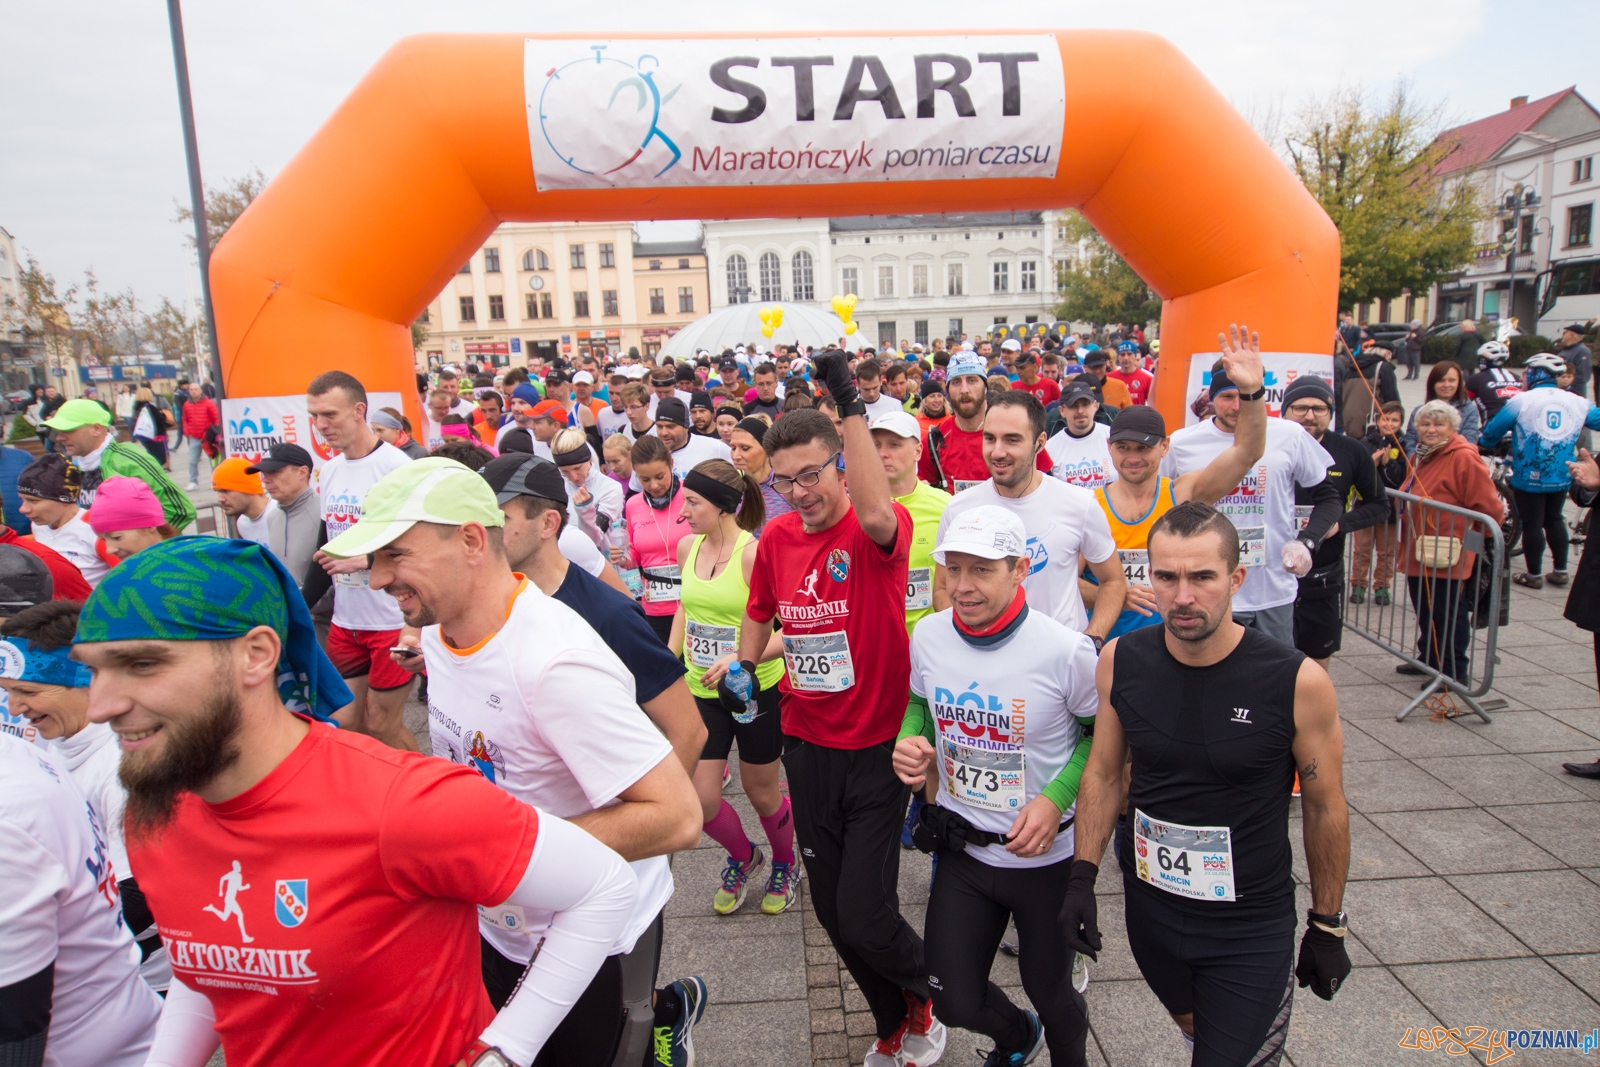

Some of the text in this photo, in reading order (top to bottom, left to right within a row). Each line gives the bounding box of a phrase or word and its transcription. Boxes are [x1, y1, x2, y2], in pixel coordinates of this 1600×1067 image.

[708, 52, 1039, 124] START
[692, 140, 1051, 174] Maratończyk pomiarczasu
[282, 415, 298, 443] OKI
[1065, 466, 1103, 477] MARATON
[1257, 465, 1267, 495] SKOKI
[1220, 505, 1265, 515] 10.2016
[693, 638, 718, 656] 231
[795, 655, 831, 675] 226
[935, 703, 1010, 730] MARATON
[1011, 698, 1026, 745] SKOKI
[955, 764, 999, 792] 473
[966, 789, 987, 801] Maciej
[1157, 846, 1192, 876] 64
[1155, 879, 1181, 892] POLINOVA
[1181, 888, 1206, 898] POLSKA
[1159, 871, 1191, 887] MARCIN
[195, 976, 279, 997] MUROWANA GOŚLINA
